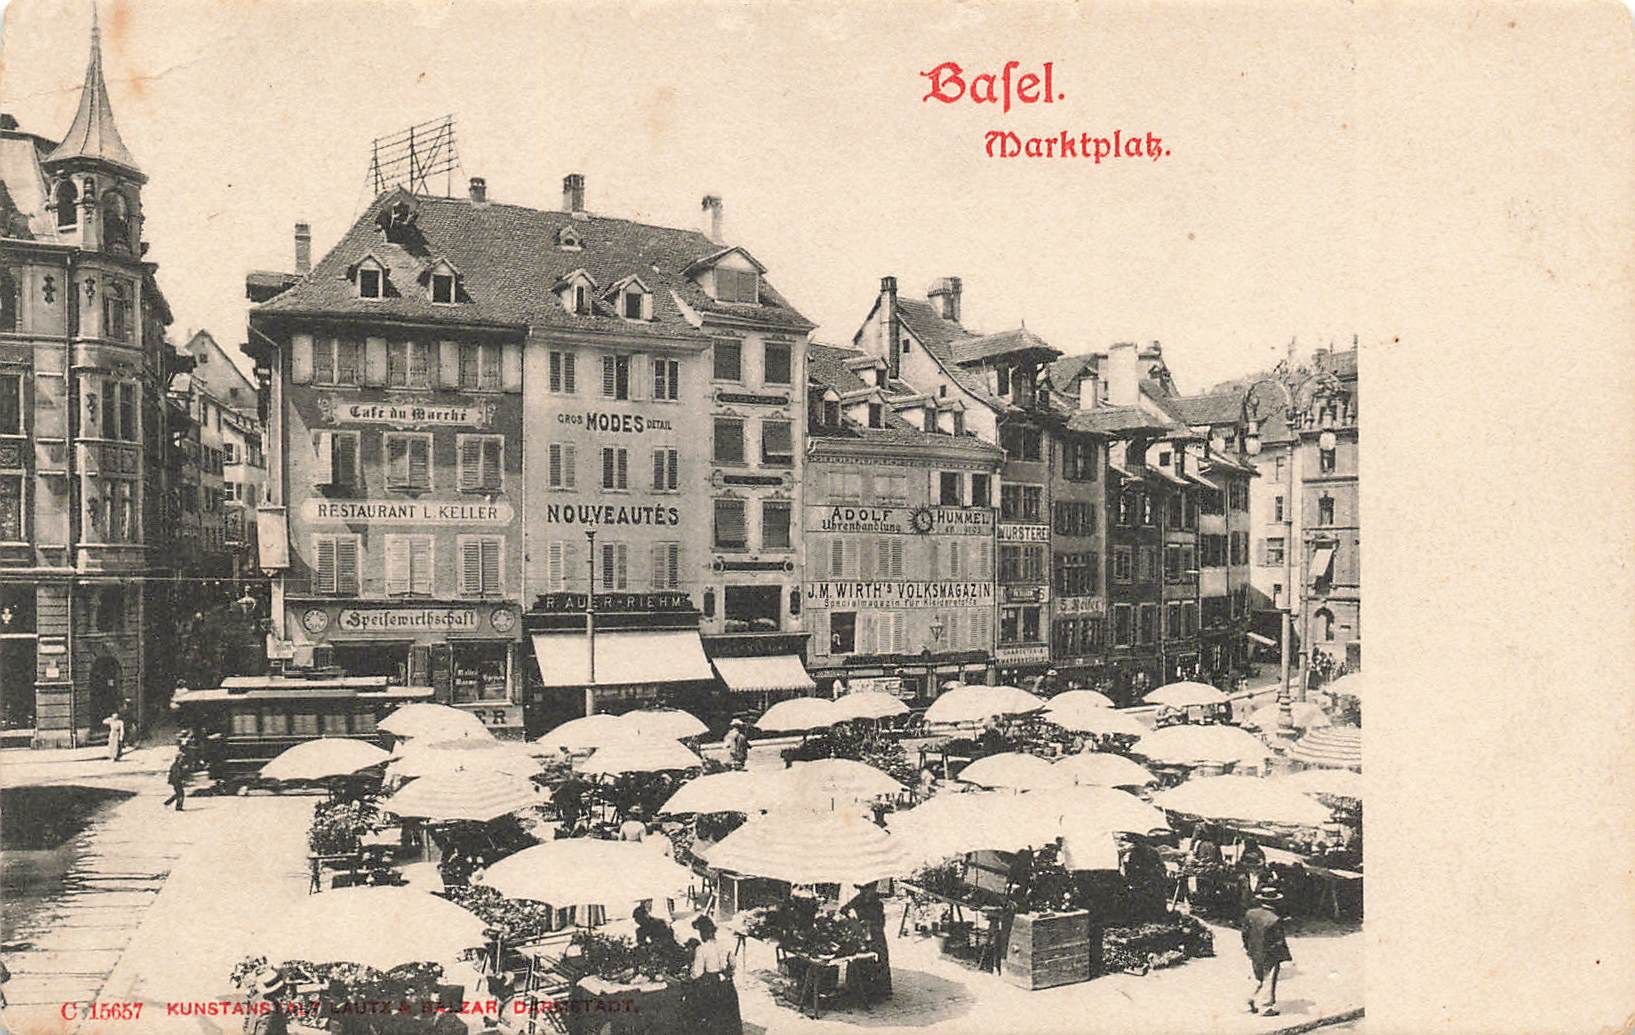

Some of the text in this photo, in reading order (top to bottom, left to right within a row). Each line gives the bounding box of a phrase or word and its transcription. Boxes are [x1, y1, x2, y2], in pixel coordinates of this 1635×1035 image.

[389, 407, 407, 420] du
[557, 413, 583, 425] GROS
[586, 412, 644, 433] MODES
[318, 503, 416, 519] RESTAURANT
[439, 505, 498, 520] KELLER
[547, 503, 680, 526] NOUVEAUTÉS
[831, 505, 990, 525] ADOLF HUMMEL
[822, 519, 902, 532] Uhrenhandlung
[897, 582, 991, 599] VOLKSMAGAZIN
